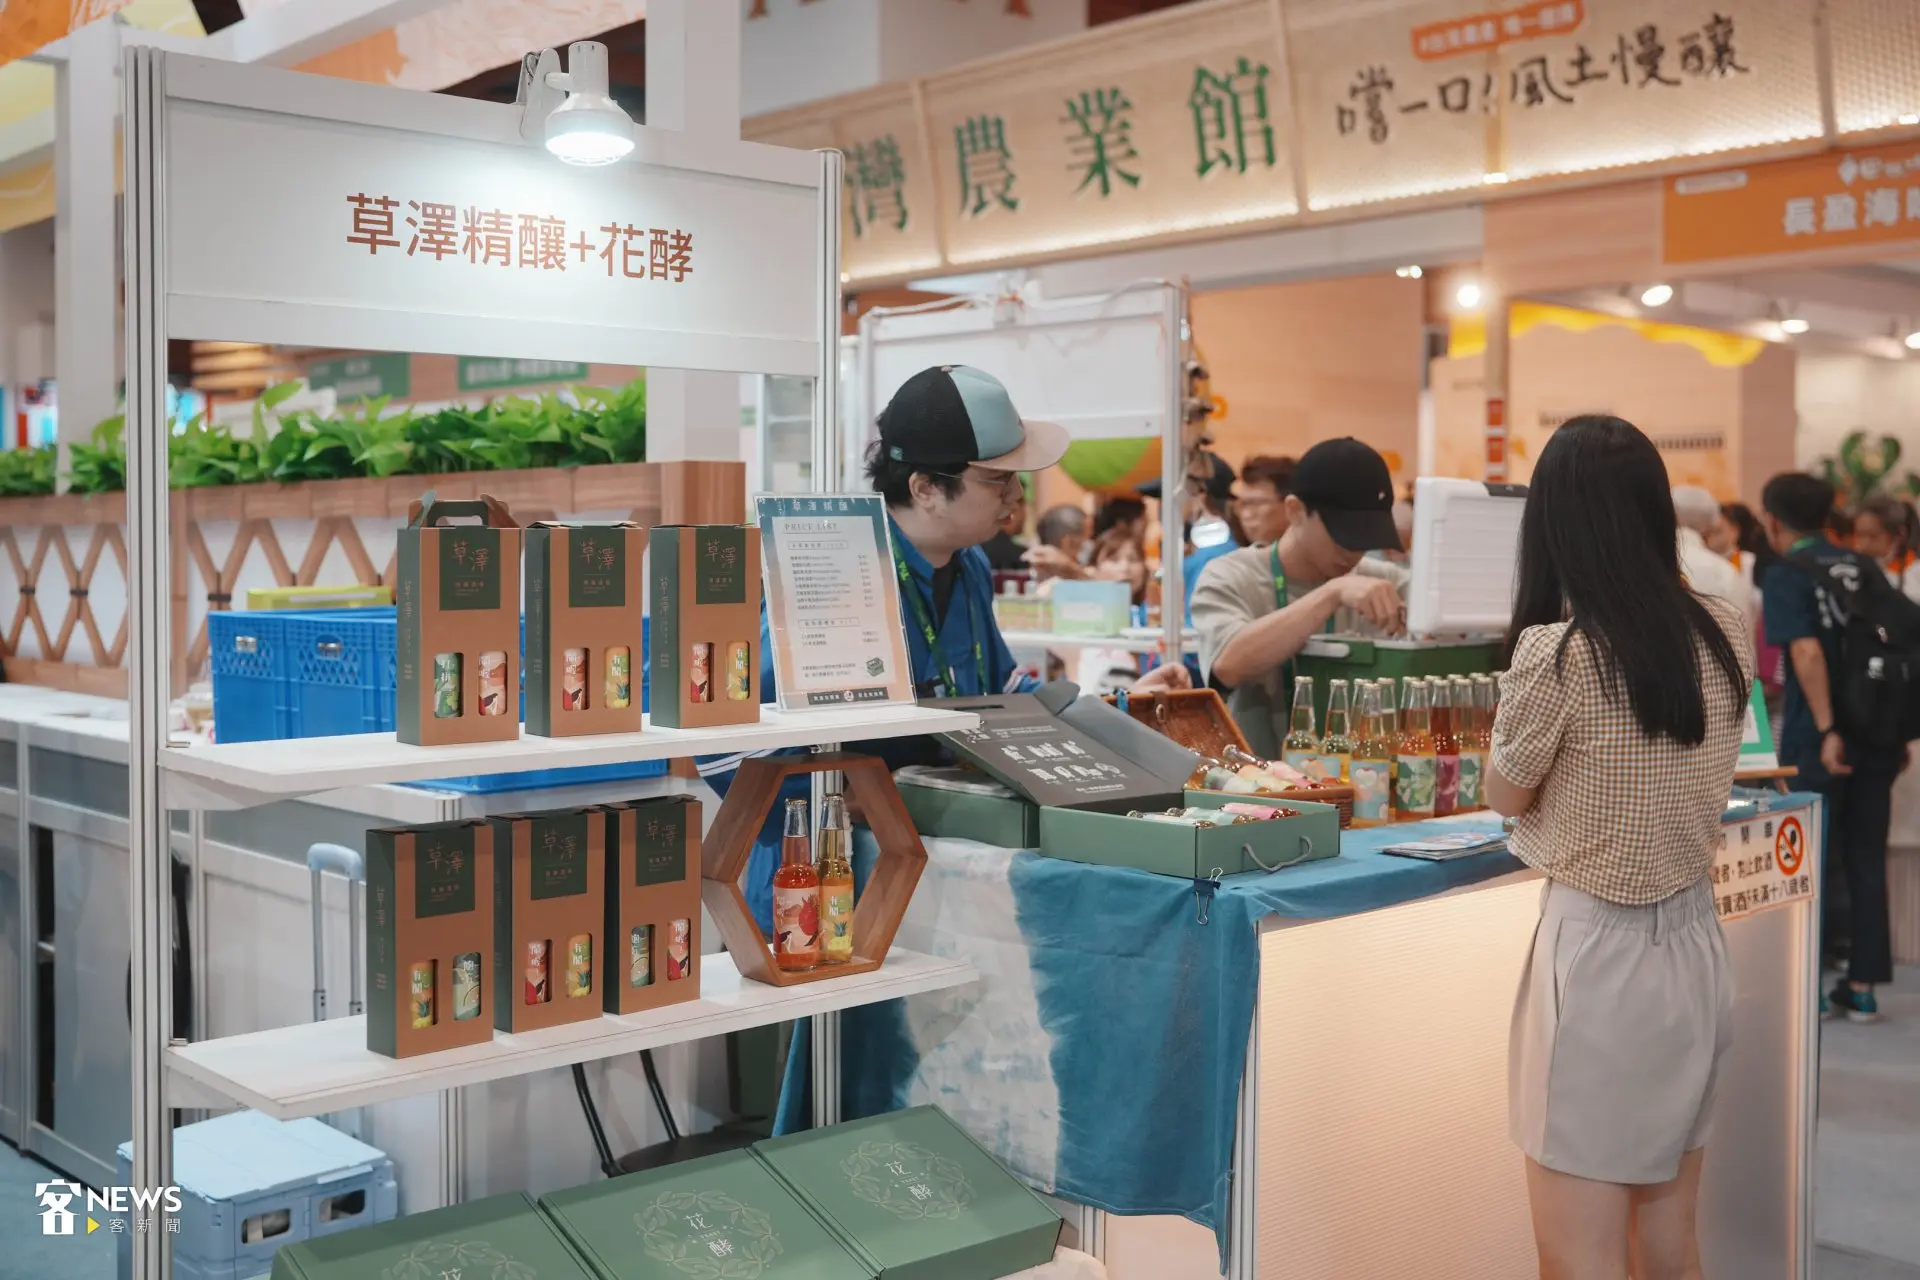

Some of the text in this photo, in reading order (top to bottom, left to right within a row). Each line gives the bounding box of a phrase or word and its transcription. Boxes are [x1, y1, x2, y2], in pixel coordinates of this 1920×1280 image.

[842, 56, 1278, 237] 灣農業館
[346, 192, 693, 283] 草澤精釀+花酵
[452, 540, 489, 572] 草澤
[580, 538, 616, 570] 草澤
[705, 538, 737, 569] 草澤
[541, 828, 577, 860] 草澤
[646, 818, 677, 848] 草澤
[426, 840, 464, 875] 草澤
